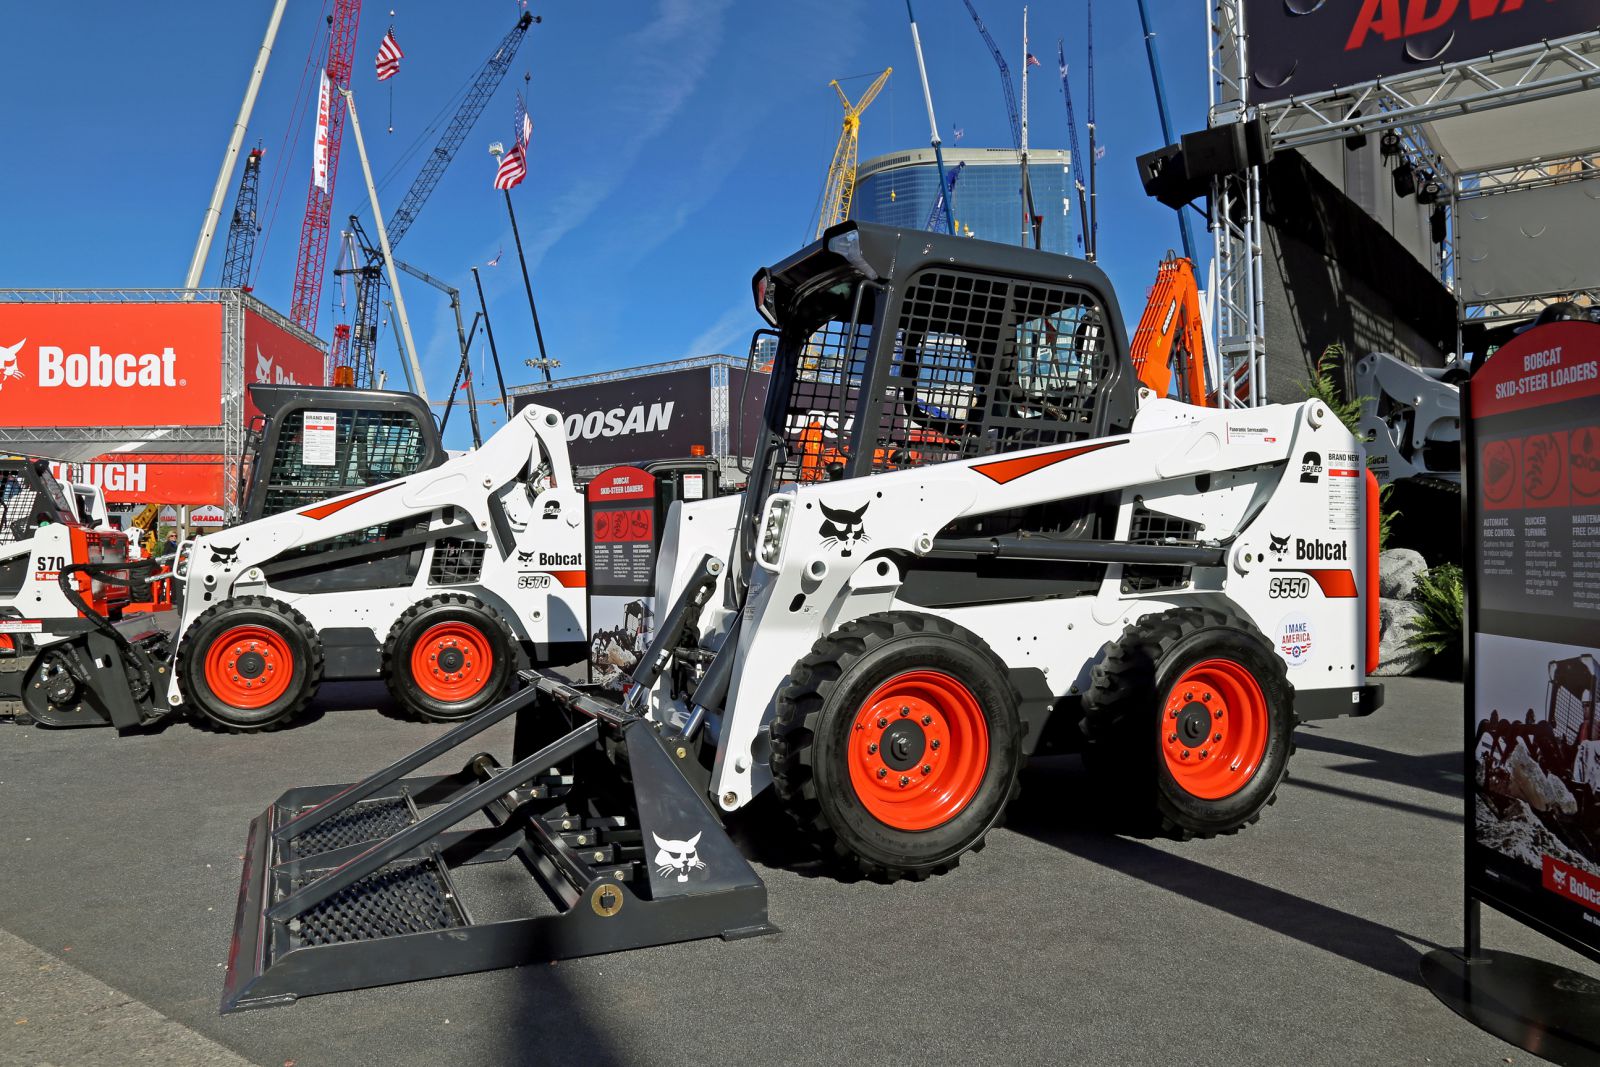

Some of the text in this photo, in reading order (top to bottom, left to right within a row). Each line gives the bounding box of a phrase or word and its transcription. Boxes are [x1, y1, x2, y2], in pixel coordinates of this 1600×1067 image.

[1344, 0, 1550, 50] AD
[38, 346, 176, 387] Bobcat
[1523, 347, 1562, 372] BOBCAT
[1495, 361, 1598, 400] SKID-STEER LOADERS
[563, 401, 675, 441] OOSAN
[1299, 451, 1322, 484] 2
[1328, 453, 1360, 462] BRAND NEW
[1301, 465, 1323, 473] SPEED
[539, 552, 582, 566] Bobcat
[1296, 538, 1347, 561] Bobcat
[37, 556, 65, 571] S70
[518, 575, 551, 589] S570
[1269, 577, 1310, 599] S550
[1281, 632, 1311, 644] AMERICA
[1288, 622, 1307, 633] MAKE
